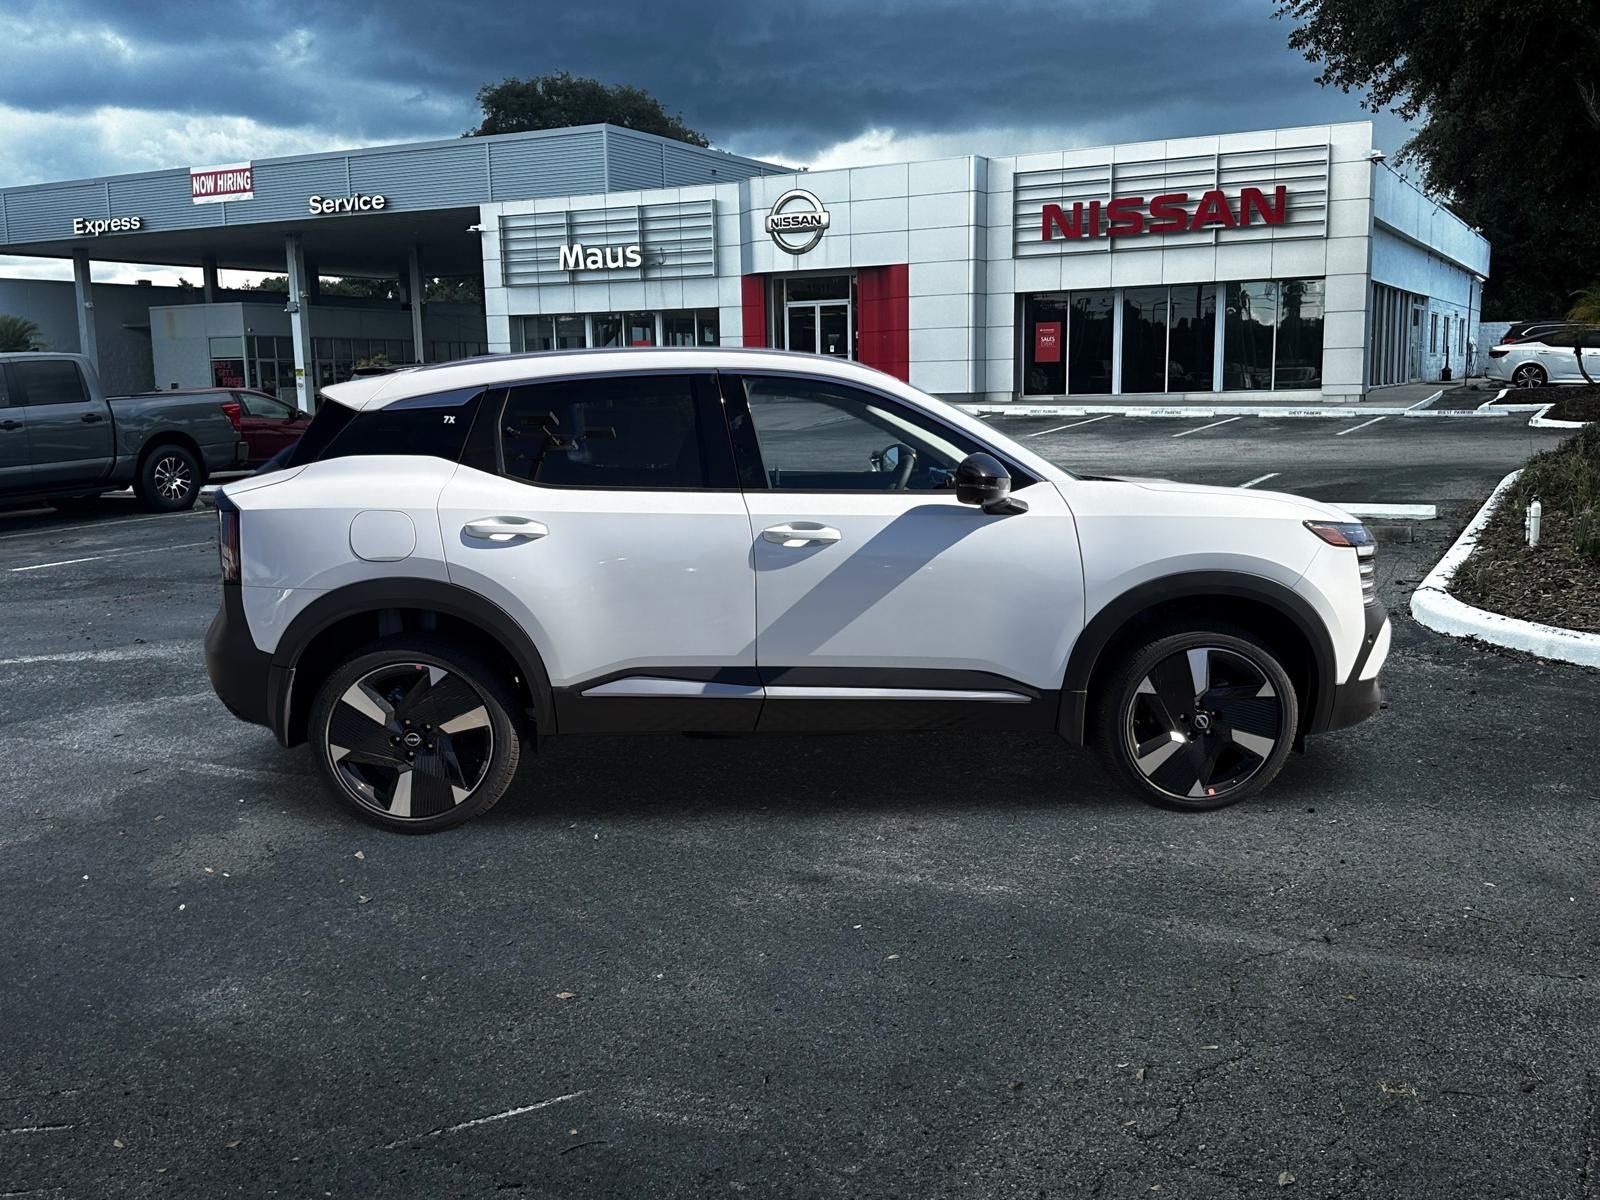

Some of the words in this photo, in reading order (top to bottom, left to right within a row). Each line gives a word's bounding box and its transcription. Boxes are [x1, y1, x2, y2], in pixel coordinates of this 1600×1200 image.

[193, 175, 215, 195] NOW
[217, 171, 251, 192] HIRING
[309, 193, 385, 214] Service
[1042, 185, 1287, 241] NISSAN
[73, 216, 141, 236] Express
[770, 215, 822, 228] NISSAN
[559, 243, 642, 270] Maus
